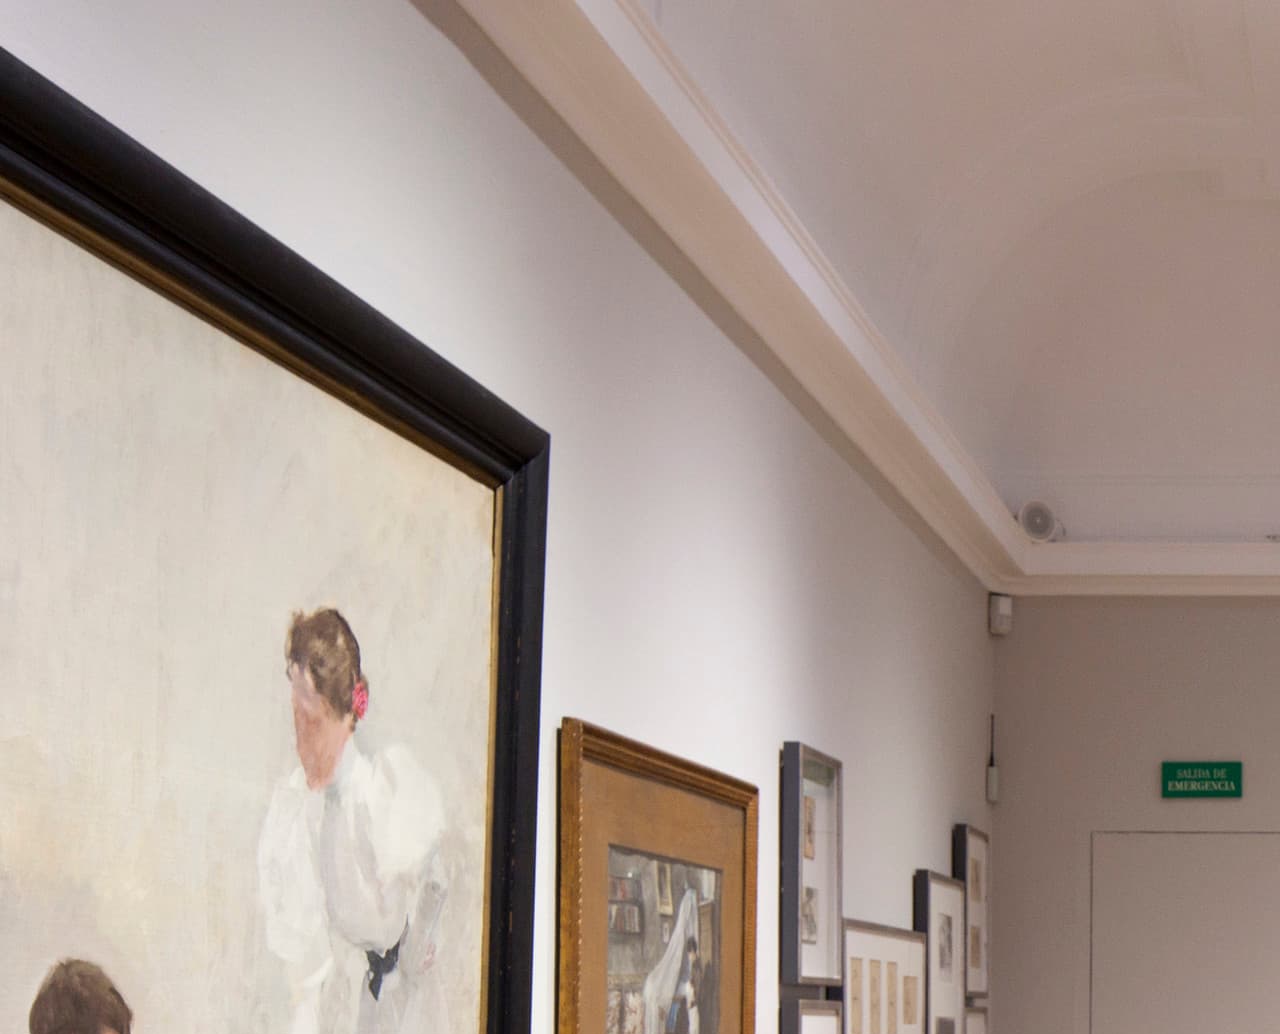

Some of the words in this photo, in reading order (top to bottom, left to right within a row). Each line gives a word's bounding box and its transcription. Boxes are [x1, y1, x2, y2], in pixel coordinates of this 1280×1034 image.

[1177, 768, 1212, 779] SALIDA
[1214, 768, 1229, 779] DE
[1168, 781, 1237, 791] EMERGENCIA
